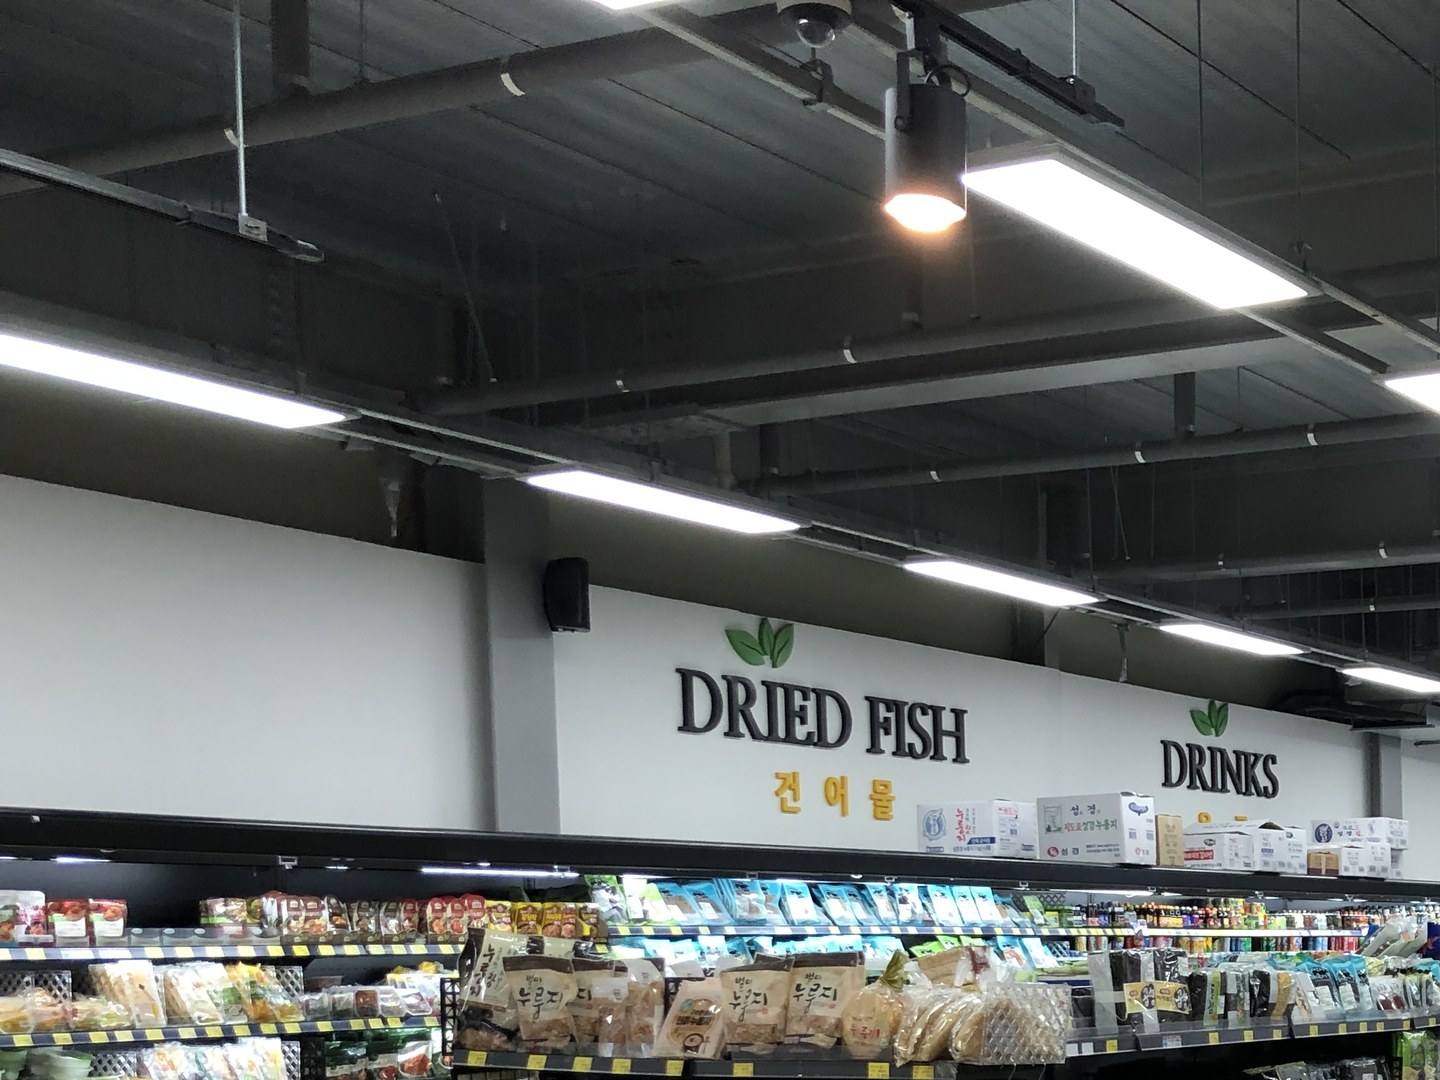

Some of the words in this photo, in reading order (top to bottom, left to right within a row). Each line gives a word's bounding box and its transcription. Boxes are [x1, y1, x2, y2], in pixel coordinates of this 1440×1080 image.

[675, 667, 853, 748] DRIED
[864, 695, 971, 764] FISH
[1160, 740, 1280, 799] DRINKS
